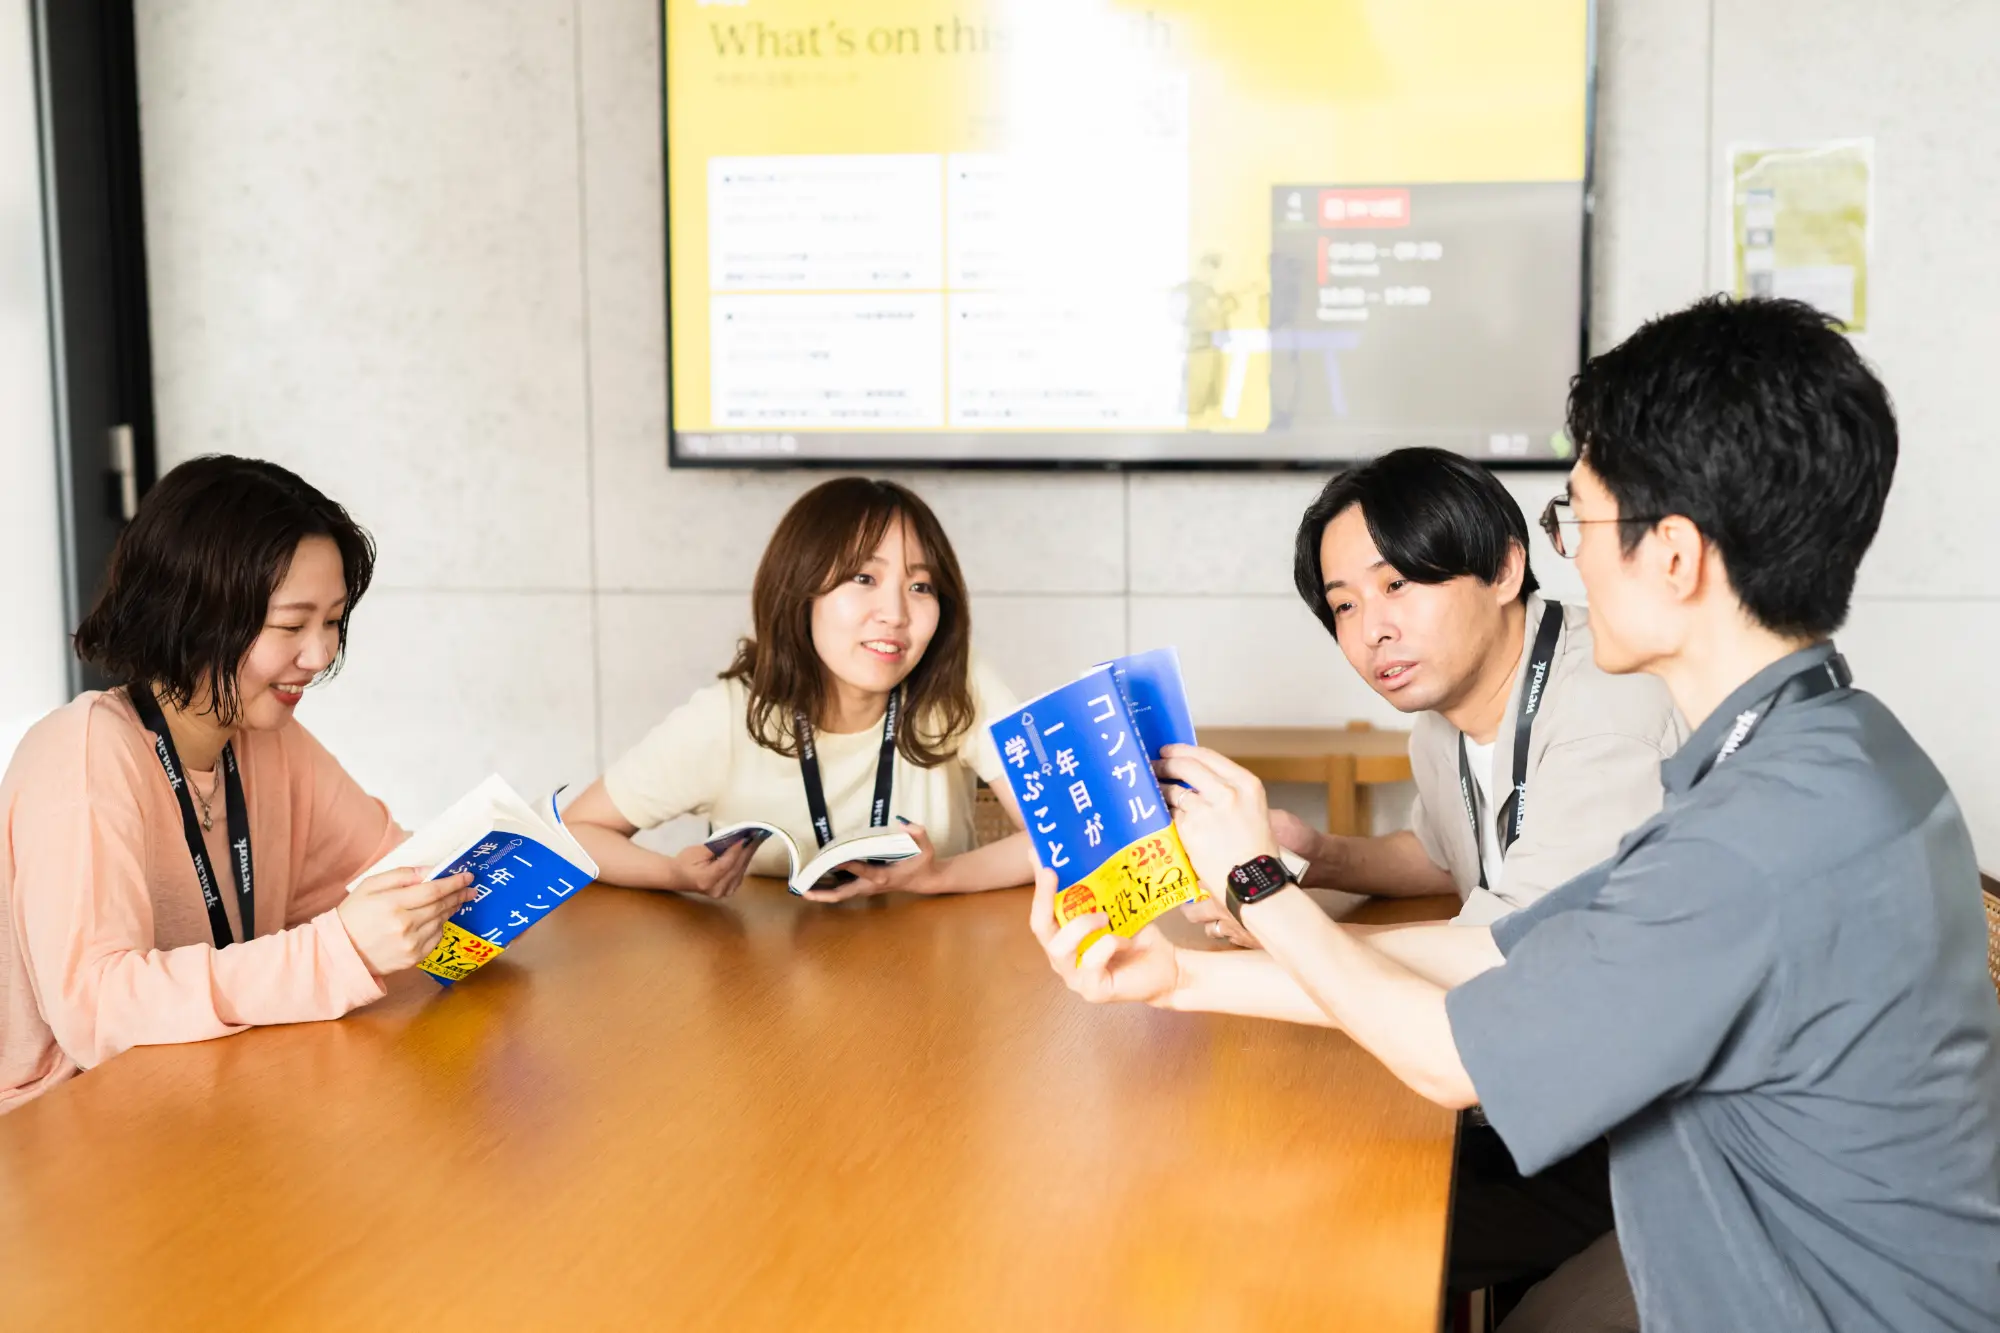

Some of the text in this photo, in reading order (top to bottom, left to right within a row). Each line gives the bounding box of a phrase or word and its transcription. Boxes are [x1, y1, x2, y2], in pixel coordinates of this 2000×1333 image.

[709, 18, 857, 58] What's
[866, 25, 920, 55] on
[1525, 659, 1548, 715] wework
[156, 734, 181, 791] wework
[1043, 721, 1105, 848] 一年目が
[1087, 693, 1157, 824] コンサル
[1004, 734, 1071, 868] 学ぶこと
[194, 853, 216, 910] wework
[232, 836, 251, 894] wework
[1132, 839, 1167, 868] 23
[481, 878, 575, 946] コンサル
[463, 940, 494, 958] 23
